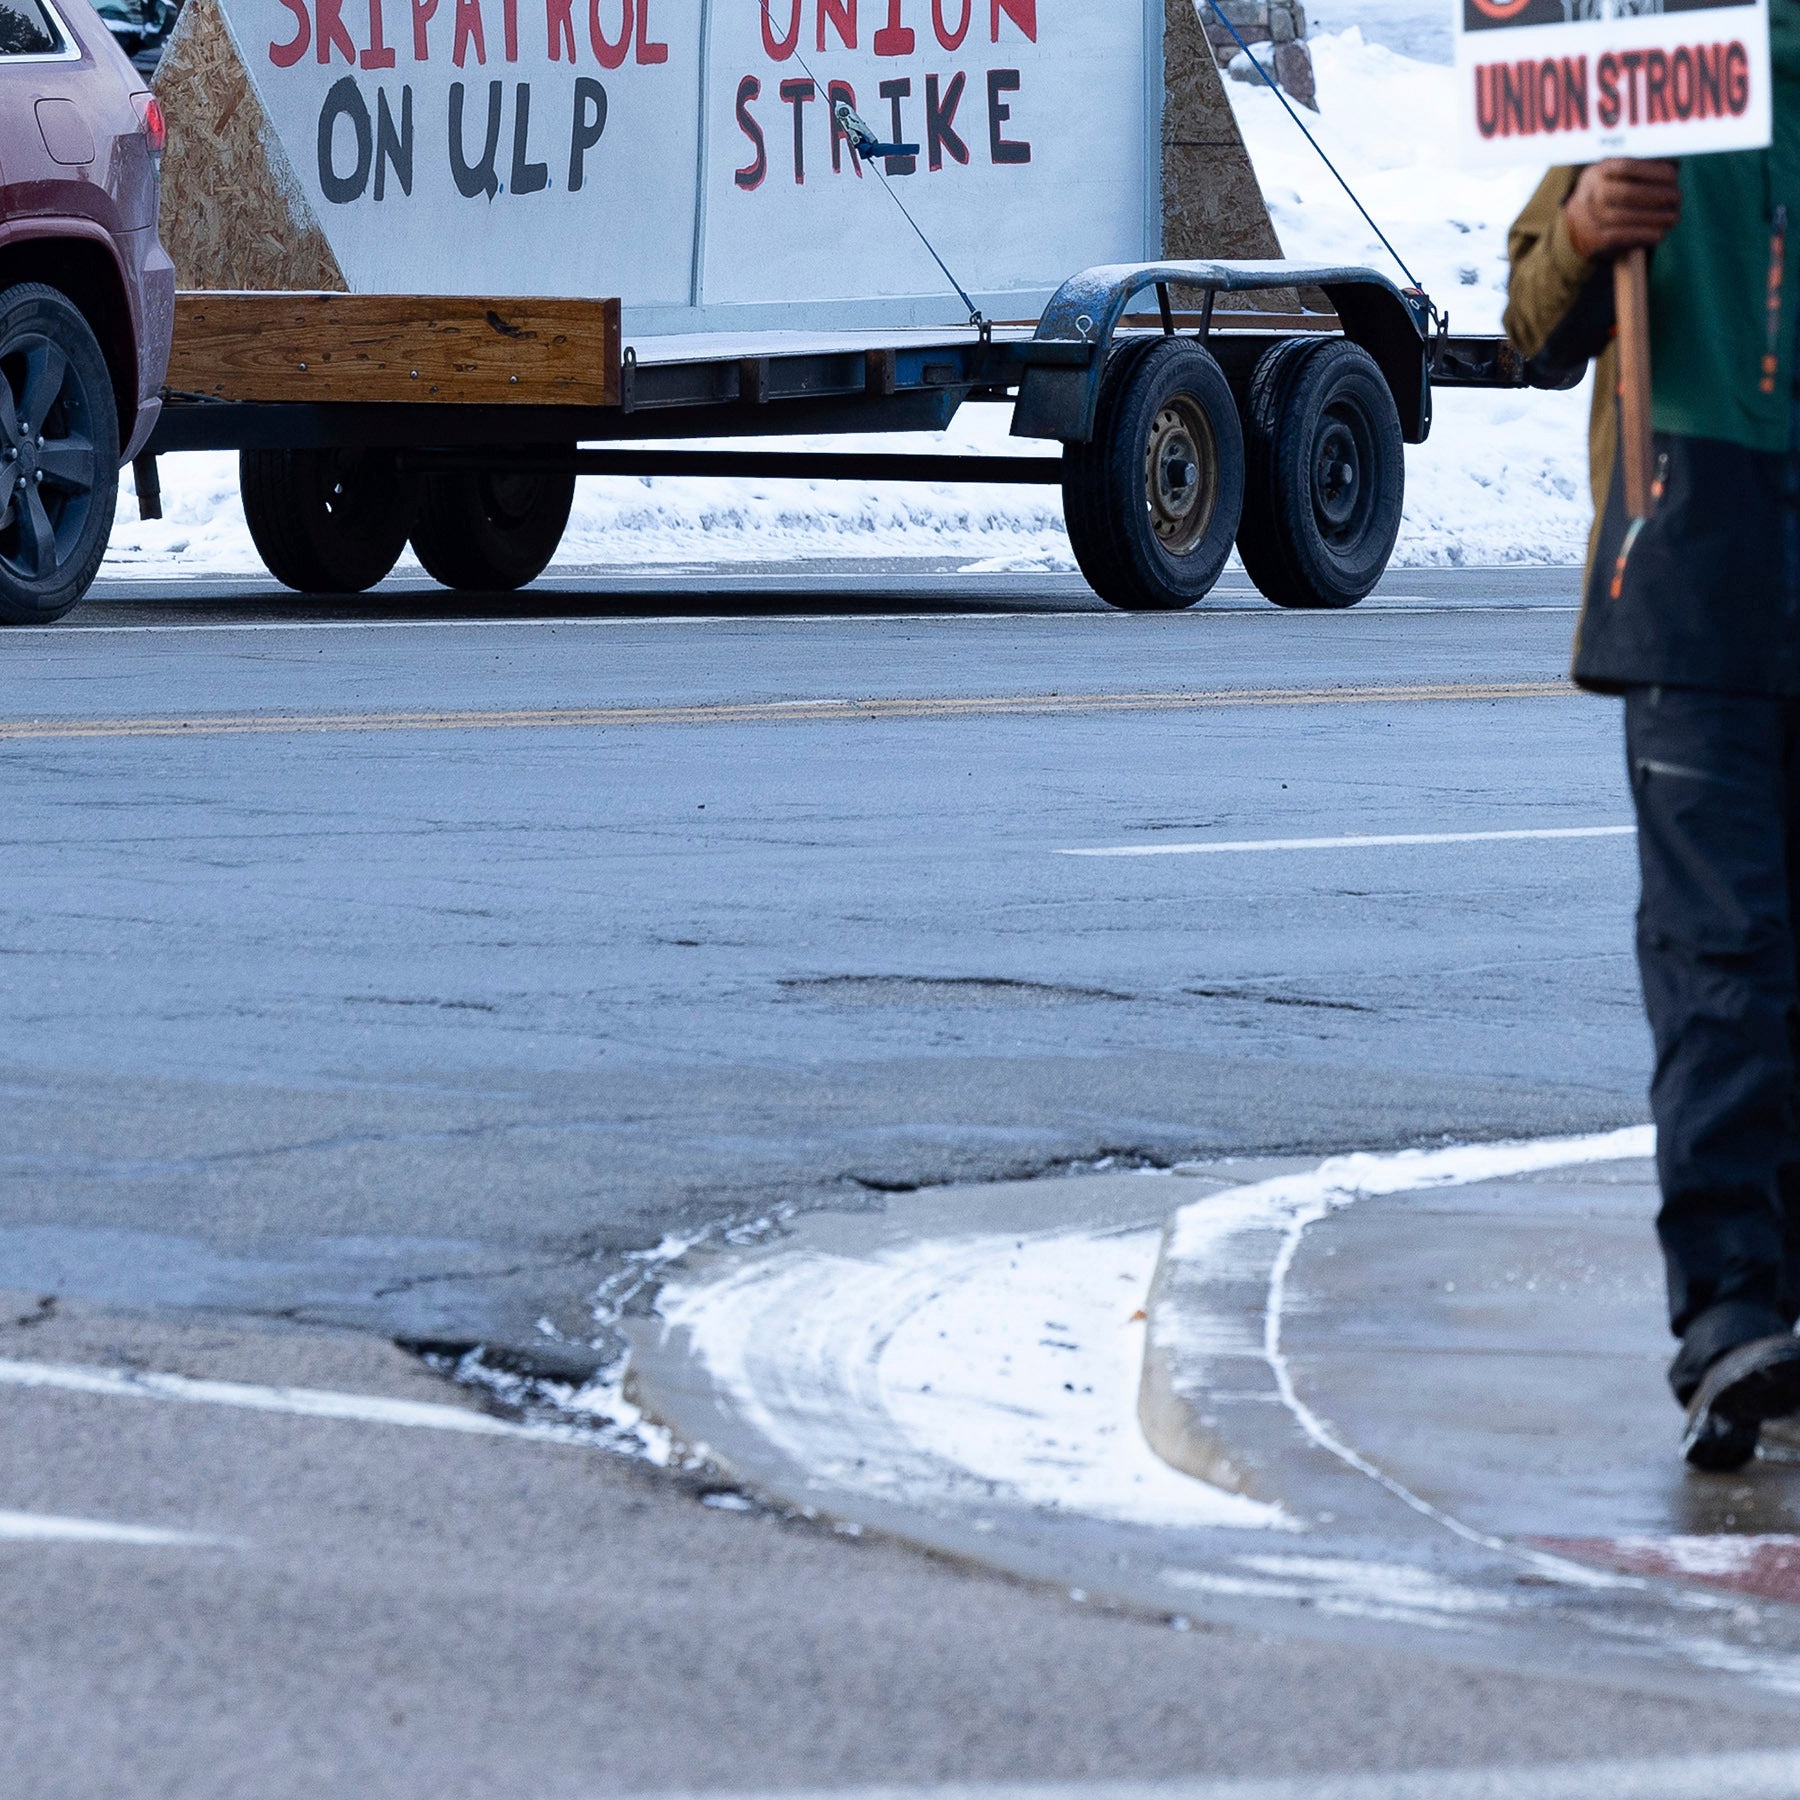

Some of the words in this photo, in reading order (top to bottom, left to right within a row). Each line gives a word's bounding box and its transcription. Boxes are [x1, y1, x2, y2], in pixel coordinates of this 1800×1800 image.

[317, 74, 413, 204] ON
[734, 69, 1031, 191] STRIKE
[1474, 53, 1590, 140] UNION
[1596, 40, 1749, 128] STRONG
